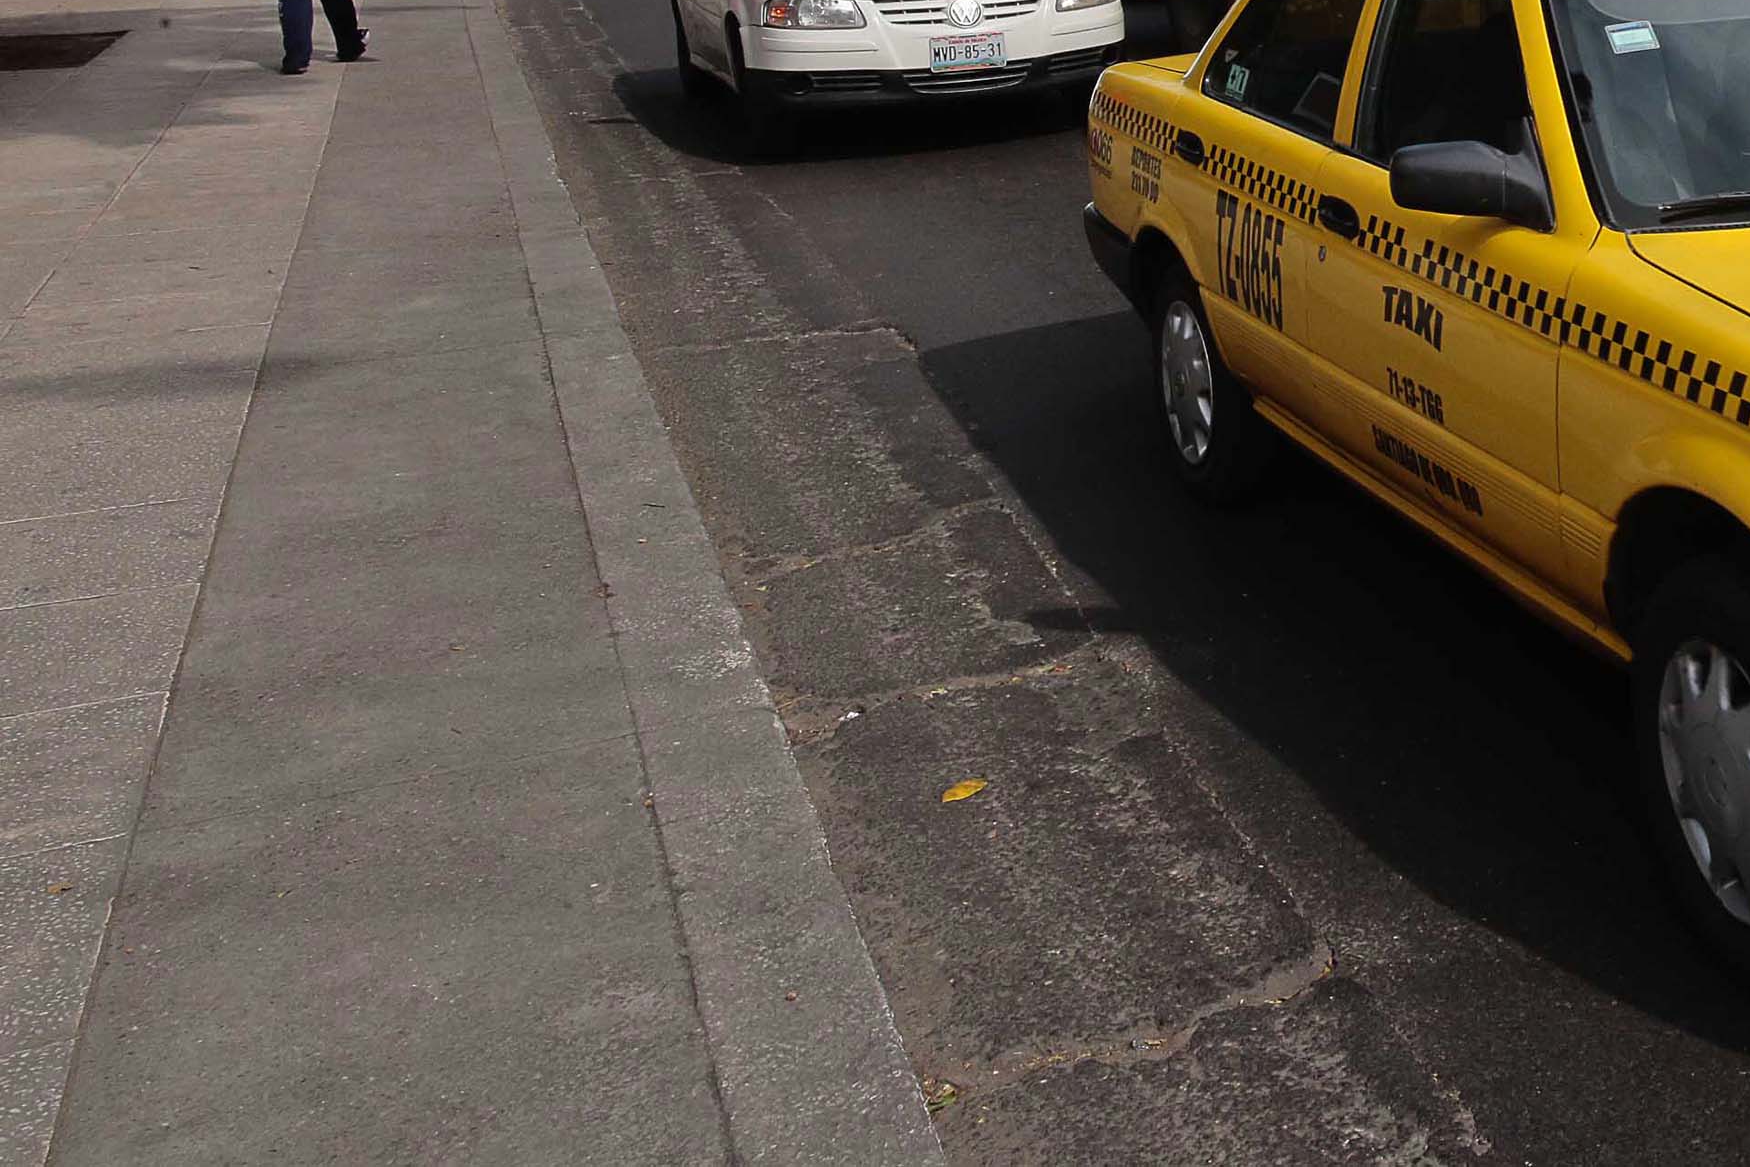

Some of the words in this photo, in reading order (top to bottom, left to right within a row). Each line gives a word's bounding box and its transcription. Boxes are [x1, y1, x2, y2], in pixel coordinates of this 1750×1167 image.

[933, 42, 1002, 63] MVD-85-31
[1216, 188, 1285, 333] TZ-0855
[1382, 285, 1444, 353] TAXI
